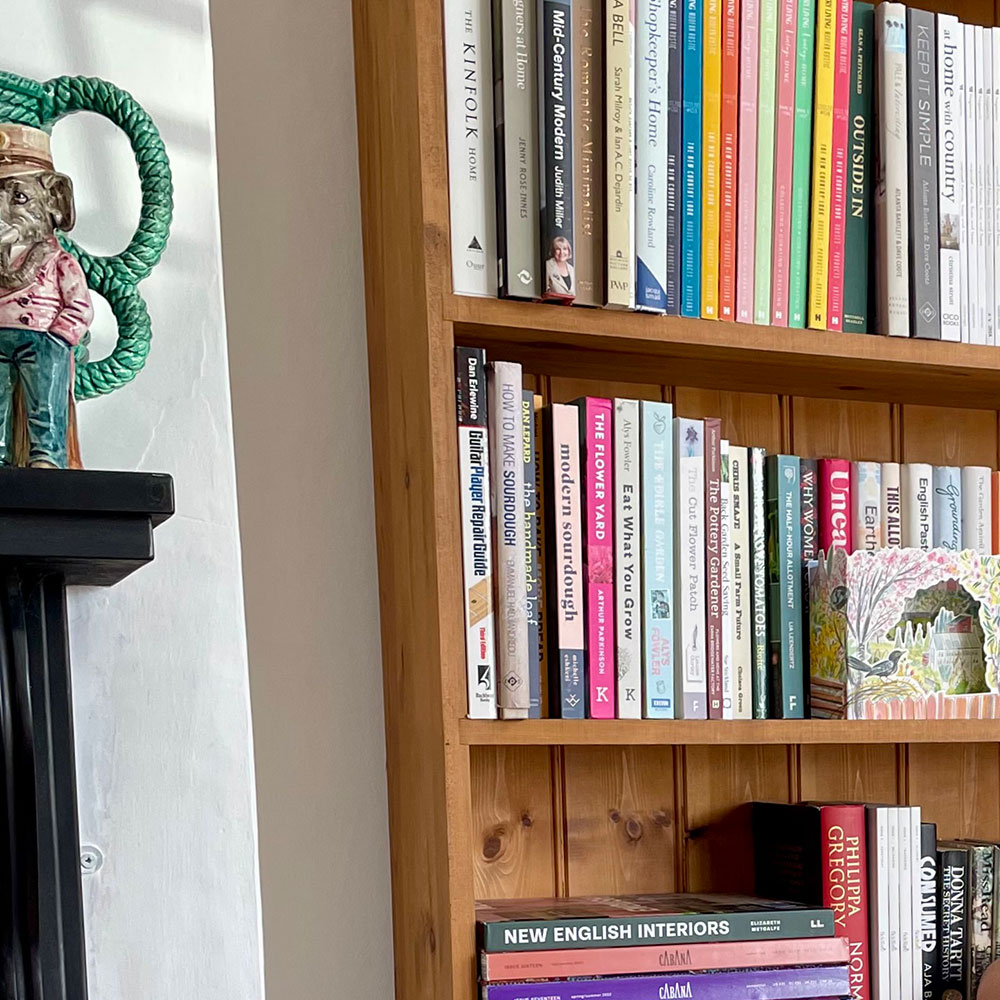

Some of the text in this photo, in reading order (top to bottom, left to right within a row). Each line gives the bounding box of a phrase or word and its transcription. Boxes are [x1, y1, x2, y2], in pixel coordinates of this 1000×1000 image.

[463, 10, 478, 181] THE KINFOLK HOME
[551, 10, 565, 160] Mid-Century Modern
[612, 95, 623, 124] Milroy
[614, 67, 623, 92] Sarah
[917, 25, 932, 167] KEEP IT SIMPLE
[942, 30, 957, 203] at home with country
[615, 136, 623, 149] Ian
[615, 152, 623, 172] A.C.
[851, 115, 864, 218] OUTSIDE IN
[555, 166, 564, 228] Judith Miller
[613, 175, 623, 212] Dejardin
[647, 165, 656, 248] Caroline Rowland
[467, 358, 479, 420] Dan Erlewine
[502, 384, 516, 546] HOW TO MAKE SOURDOUGH
[523, 426, 531, 463] LEPARD
[595, 413, 605, 540] THE FLOWER YARD
[622, 420, 632, 472] Alys Fowler
[732, 460, 740, 492] CHRIS
[524, 483, 534, 507] the
[560, 444, 578, 621] modern sourdough
[524, 511, 537, 592] handmade
[623, 484, 634, 640] Eat What You Grow
[688, 468, 698, 612] The Cut Flower Patch
[707, 479, 719, 618] The Pottery Gardener
[526, 596, 537, 626] loaf
[597, 687, 609, 702] K
[828, 826, 846, 927] GREGORY
[846, 836, 860, 917] PHILIPPA
[921, 856, 936, 952] CONSUMED
[980, 851, 992, 932] Miss Read
[504, 920, 730, 944] NEW ENGLISH INTERIORS
[659, 950, 692, 966] CABANA
[942, 866, 951, 982] THE SECRET HISTORY
[950, 866, 964, 981] DONNA TARTT
[659, 982, 692, 999] CABANA
[924, 963, 932, 987] AJA
